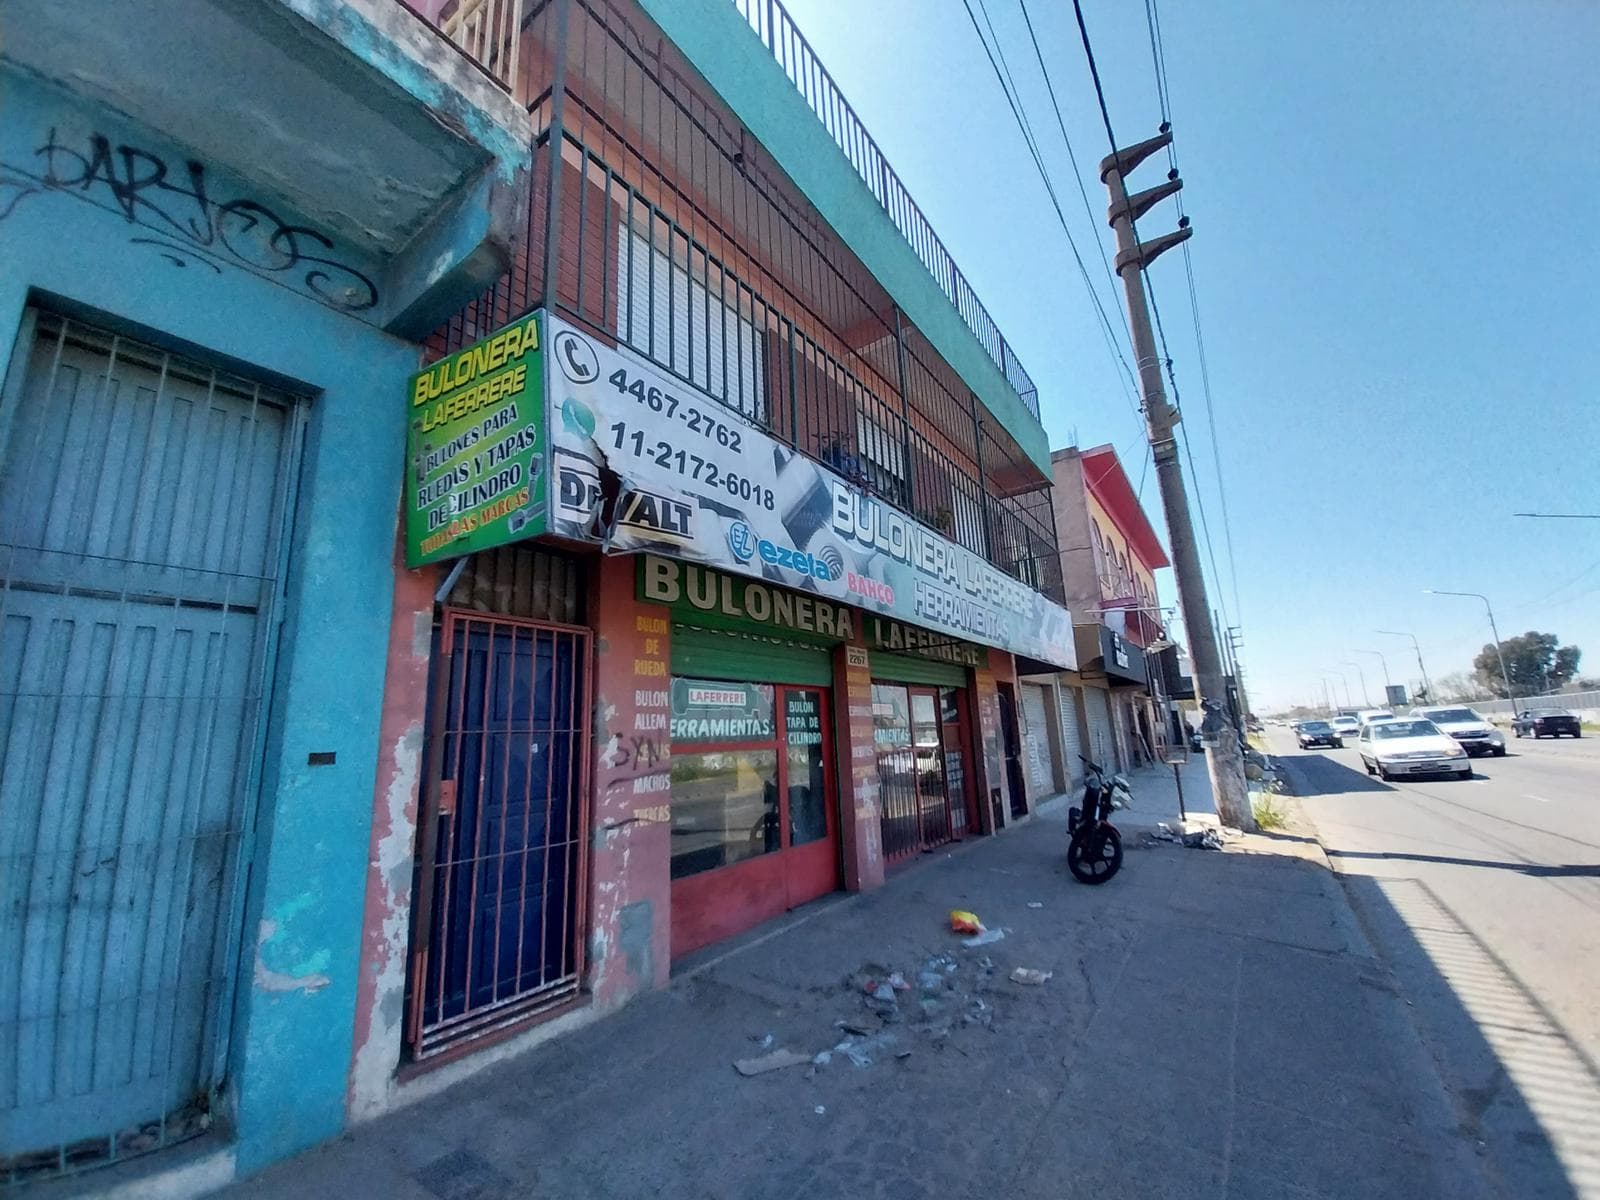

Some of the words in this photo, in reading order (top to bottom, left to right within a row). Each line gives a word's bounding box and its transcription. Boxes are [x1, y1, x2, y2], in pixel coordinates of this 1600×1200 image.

[414, 319, 539, 406] BULONERA
[422, 364, 527, 433] LAFERRERE
[608, 368, 742, 454] 4467-2762
[426, 427, 479, 474] BULONES
[483, 402, 518, 438] PARA
[417, 463, 469, 511] RUEDAS
[474, 454, 484, 477] Y
[487, 424, 536, 469] TAPAS
[611, 421, 775, 511] 11-2172-6018
[428, 506, 447, 532] DE
[448, 463, 522, 514] CILINDRO
[480, 487, 530, 526] MARCAS
[831, 480, 960, 590] BULONERA
[757, 537, 832, 581] ezeta
[645, 553, 855, 640] BULONERA
[847, 572, 895, 608] BAHCO
[913, 577, 1009, 642] HERRAMIENTAS
[635, 615, 668, 635] BULON
[645, 639, 660, 655] DE
[634, 658, 667, 676] RUEDA
[635, 690, 669, 707] BULON
[690, 690, 746, 705] LAFERRERE
[788, 700, 814, 714] BULON
[634, 713, 667, 730] ALLEM
[786, 716, 806, 729] TAPA
[809, 716, 820, 729] DE
[788, 731, 823, 745] CILINDRO
[633, 773, 671, 795] MACHOS
